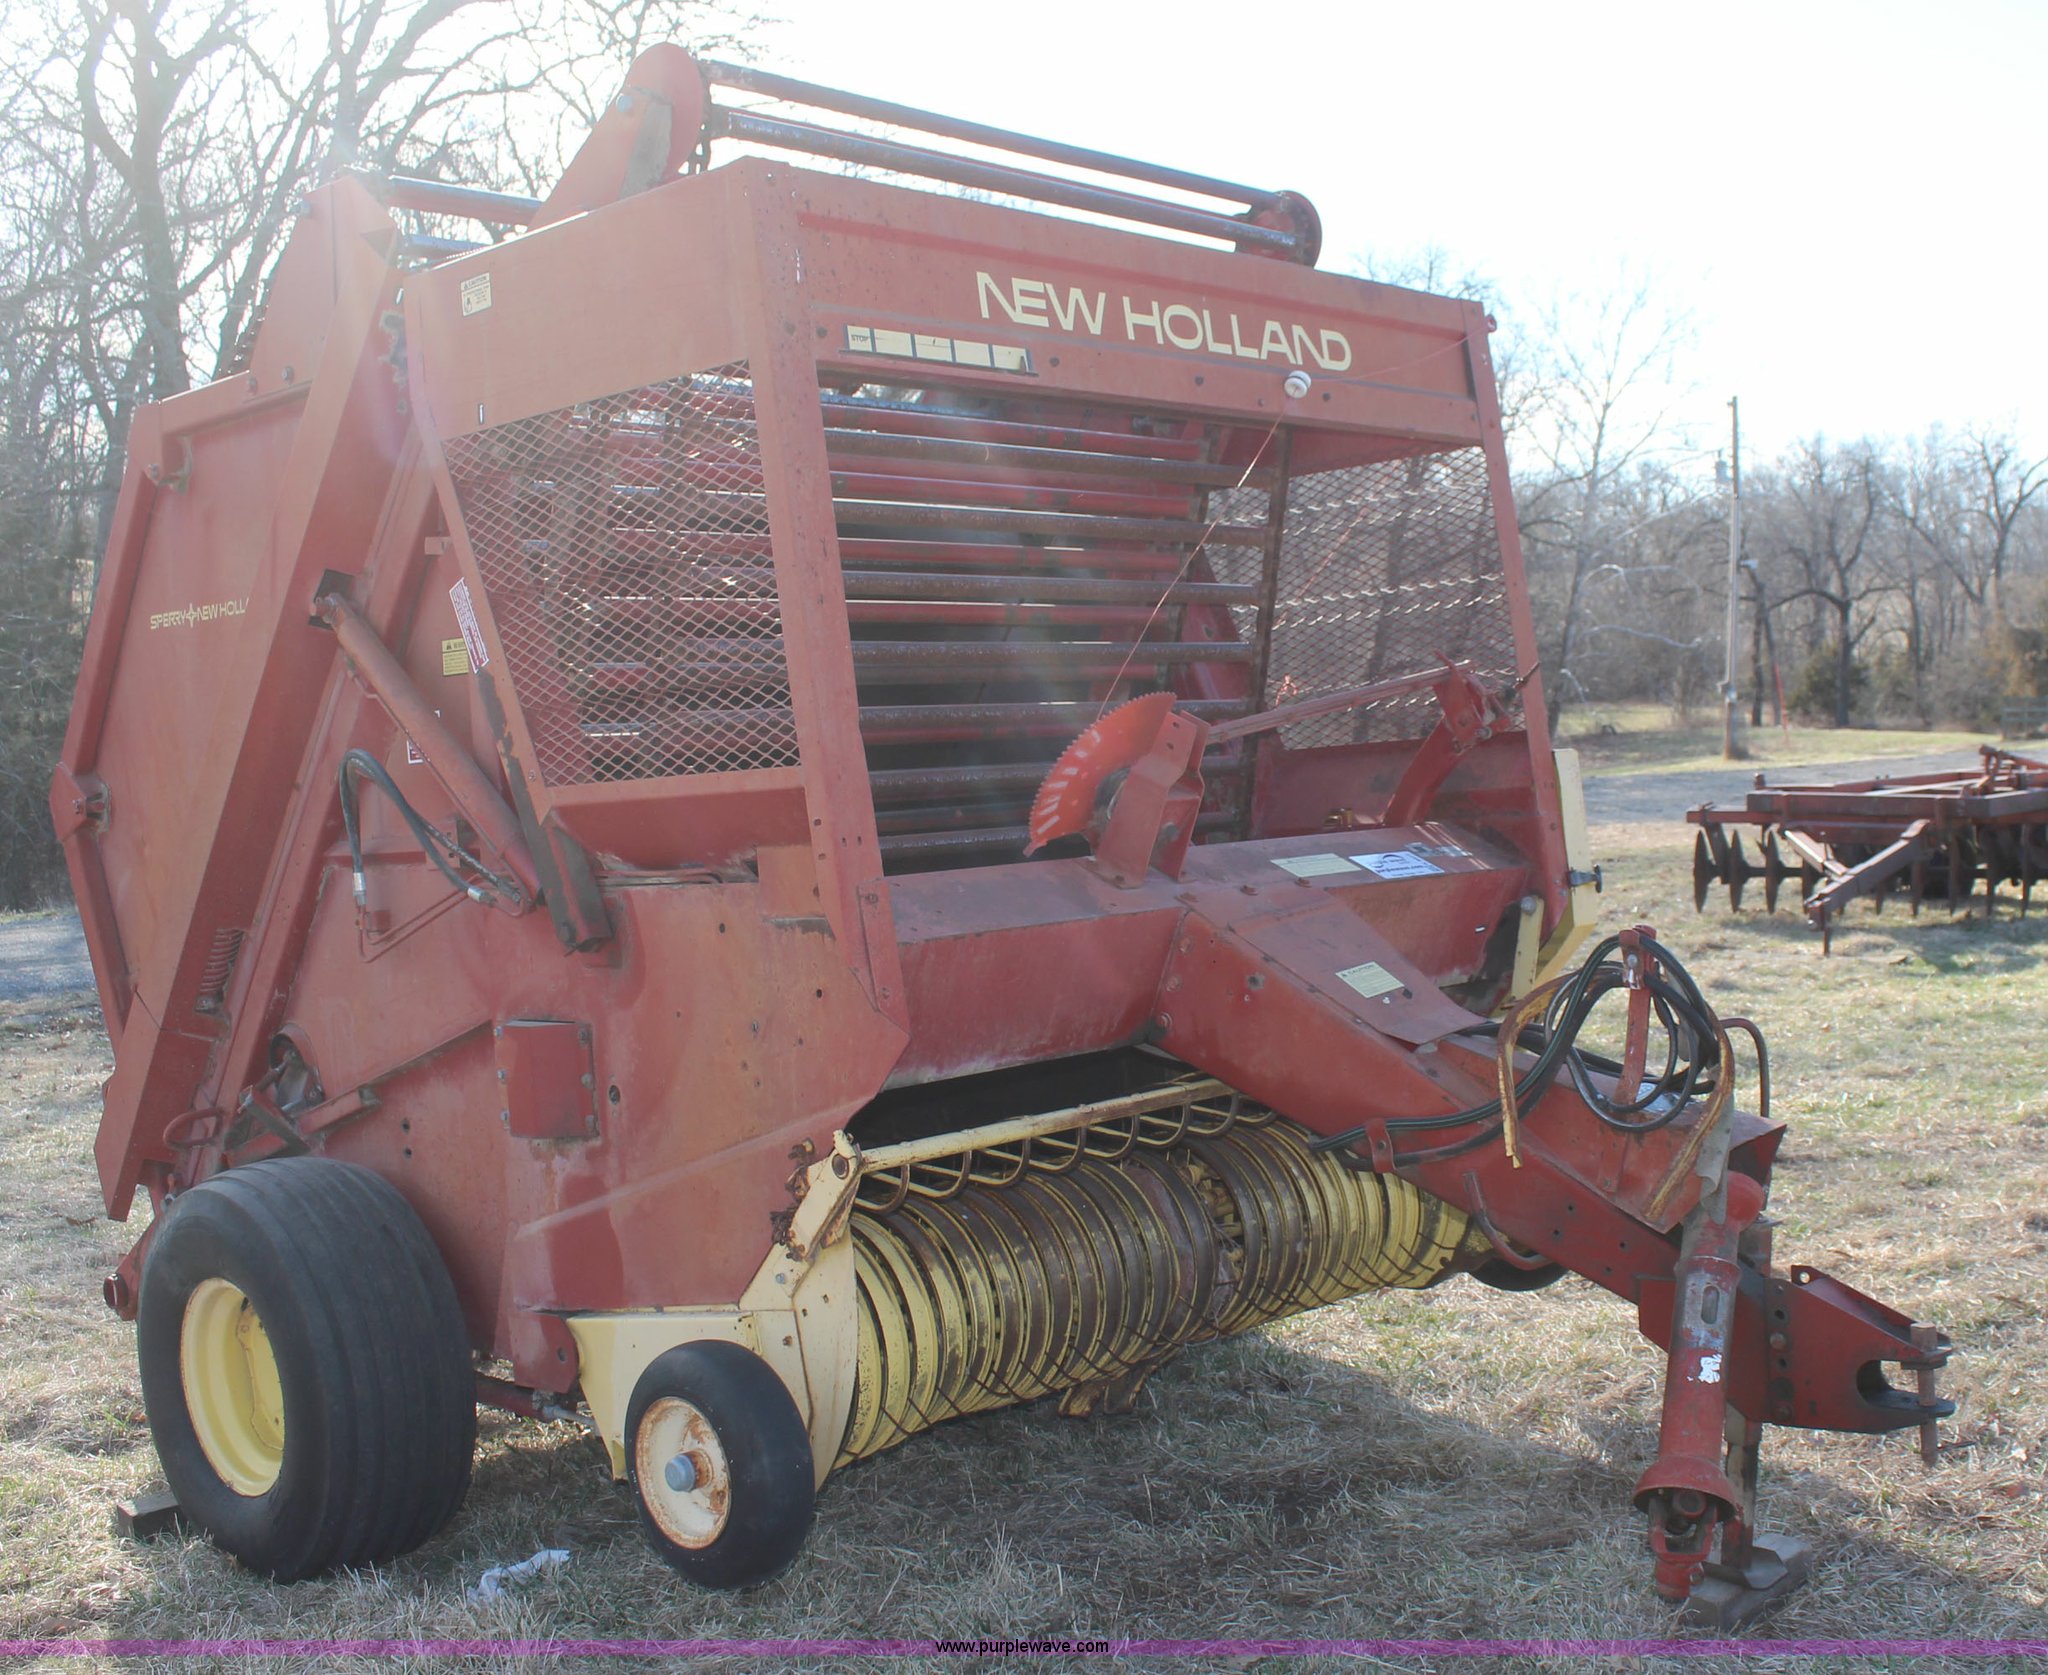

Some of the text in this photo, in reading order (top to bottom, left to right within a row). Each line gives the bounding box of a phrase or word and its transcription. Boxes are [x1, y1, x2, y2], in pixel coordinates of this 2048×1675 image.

[976, 271, 1352, 372] NEW HOLLAND
[150, 597, 249, 630] SPERRY NEW HOLL
